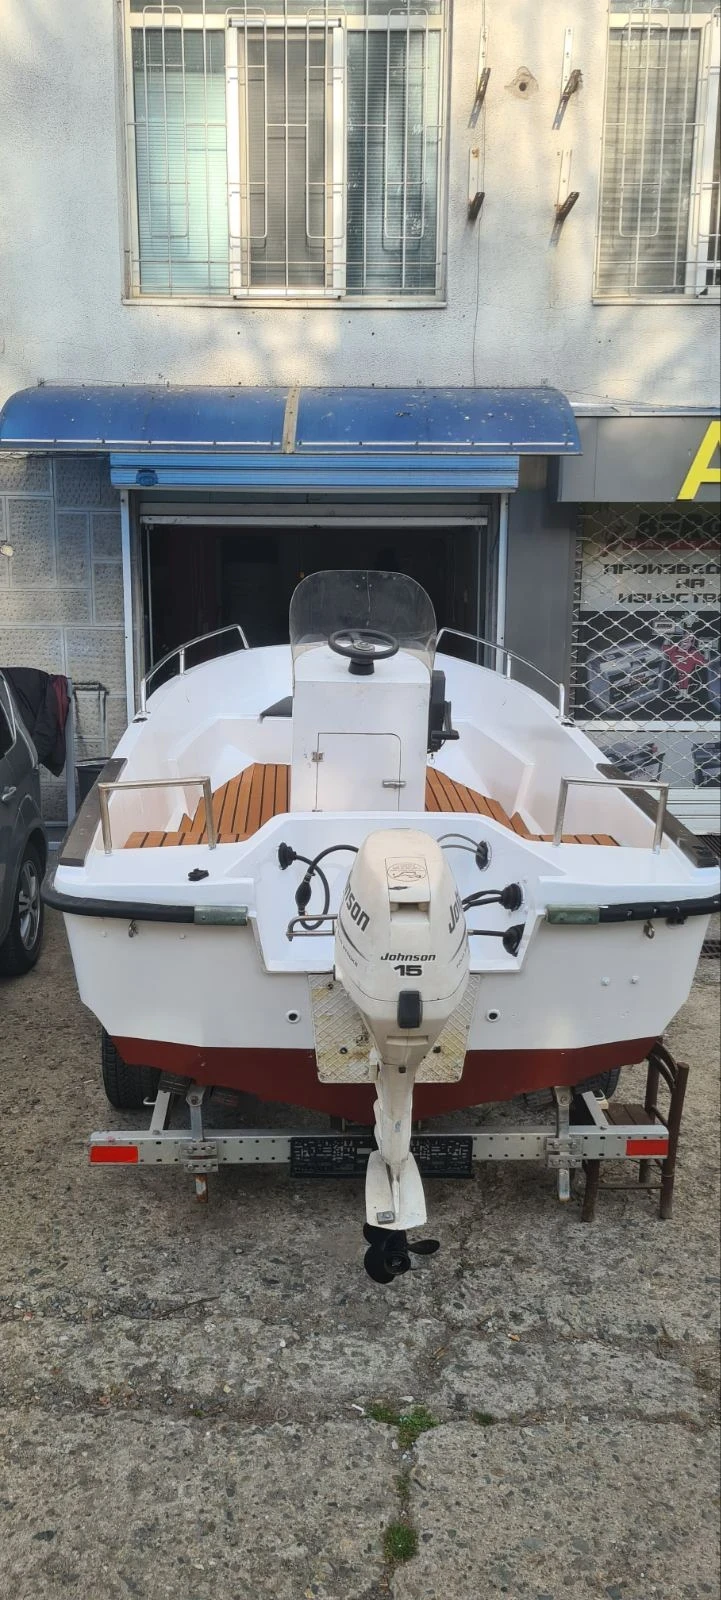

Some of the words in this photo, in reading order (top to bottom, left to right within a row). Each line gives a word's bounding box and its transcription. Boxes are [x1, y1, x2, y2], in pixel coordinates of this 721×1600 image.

[675, 578, 706, 589] НА
[618, 593, 720, 604] ИЗКУСТВ
[380, 952, 436, 962] Johnson
[393, 964, 423, 977] 15
